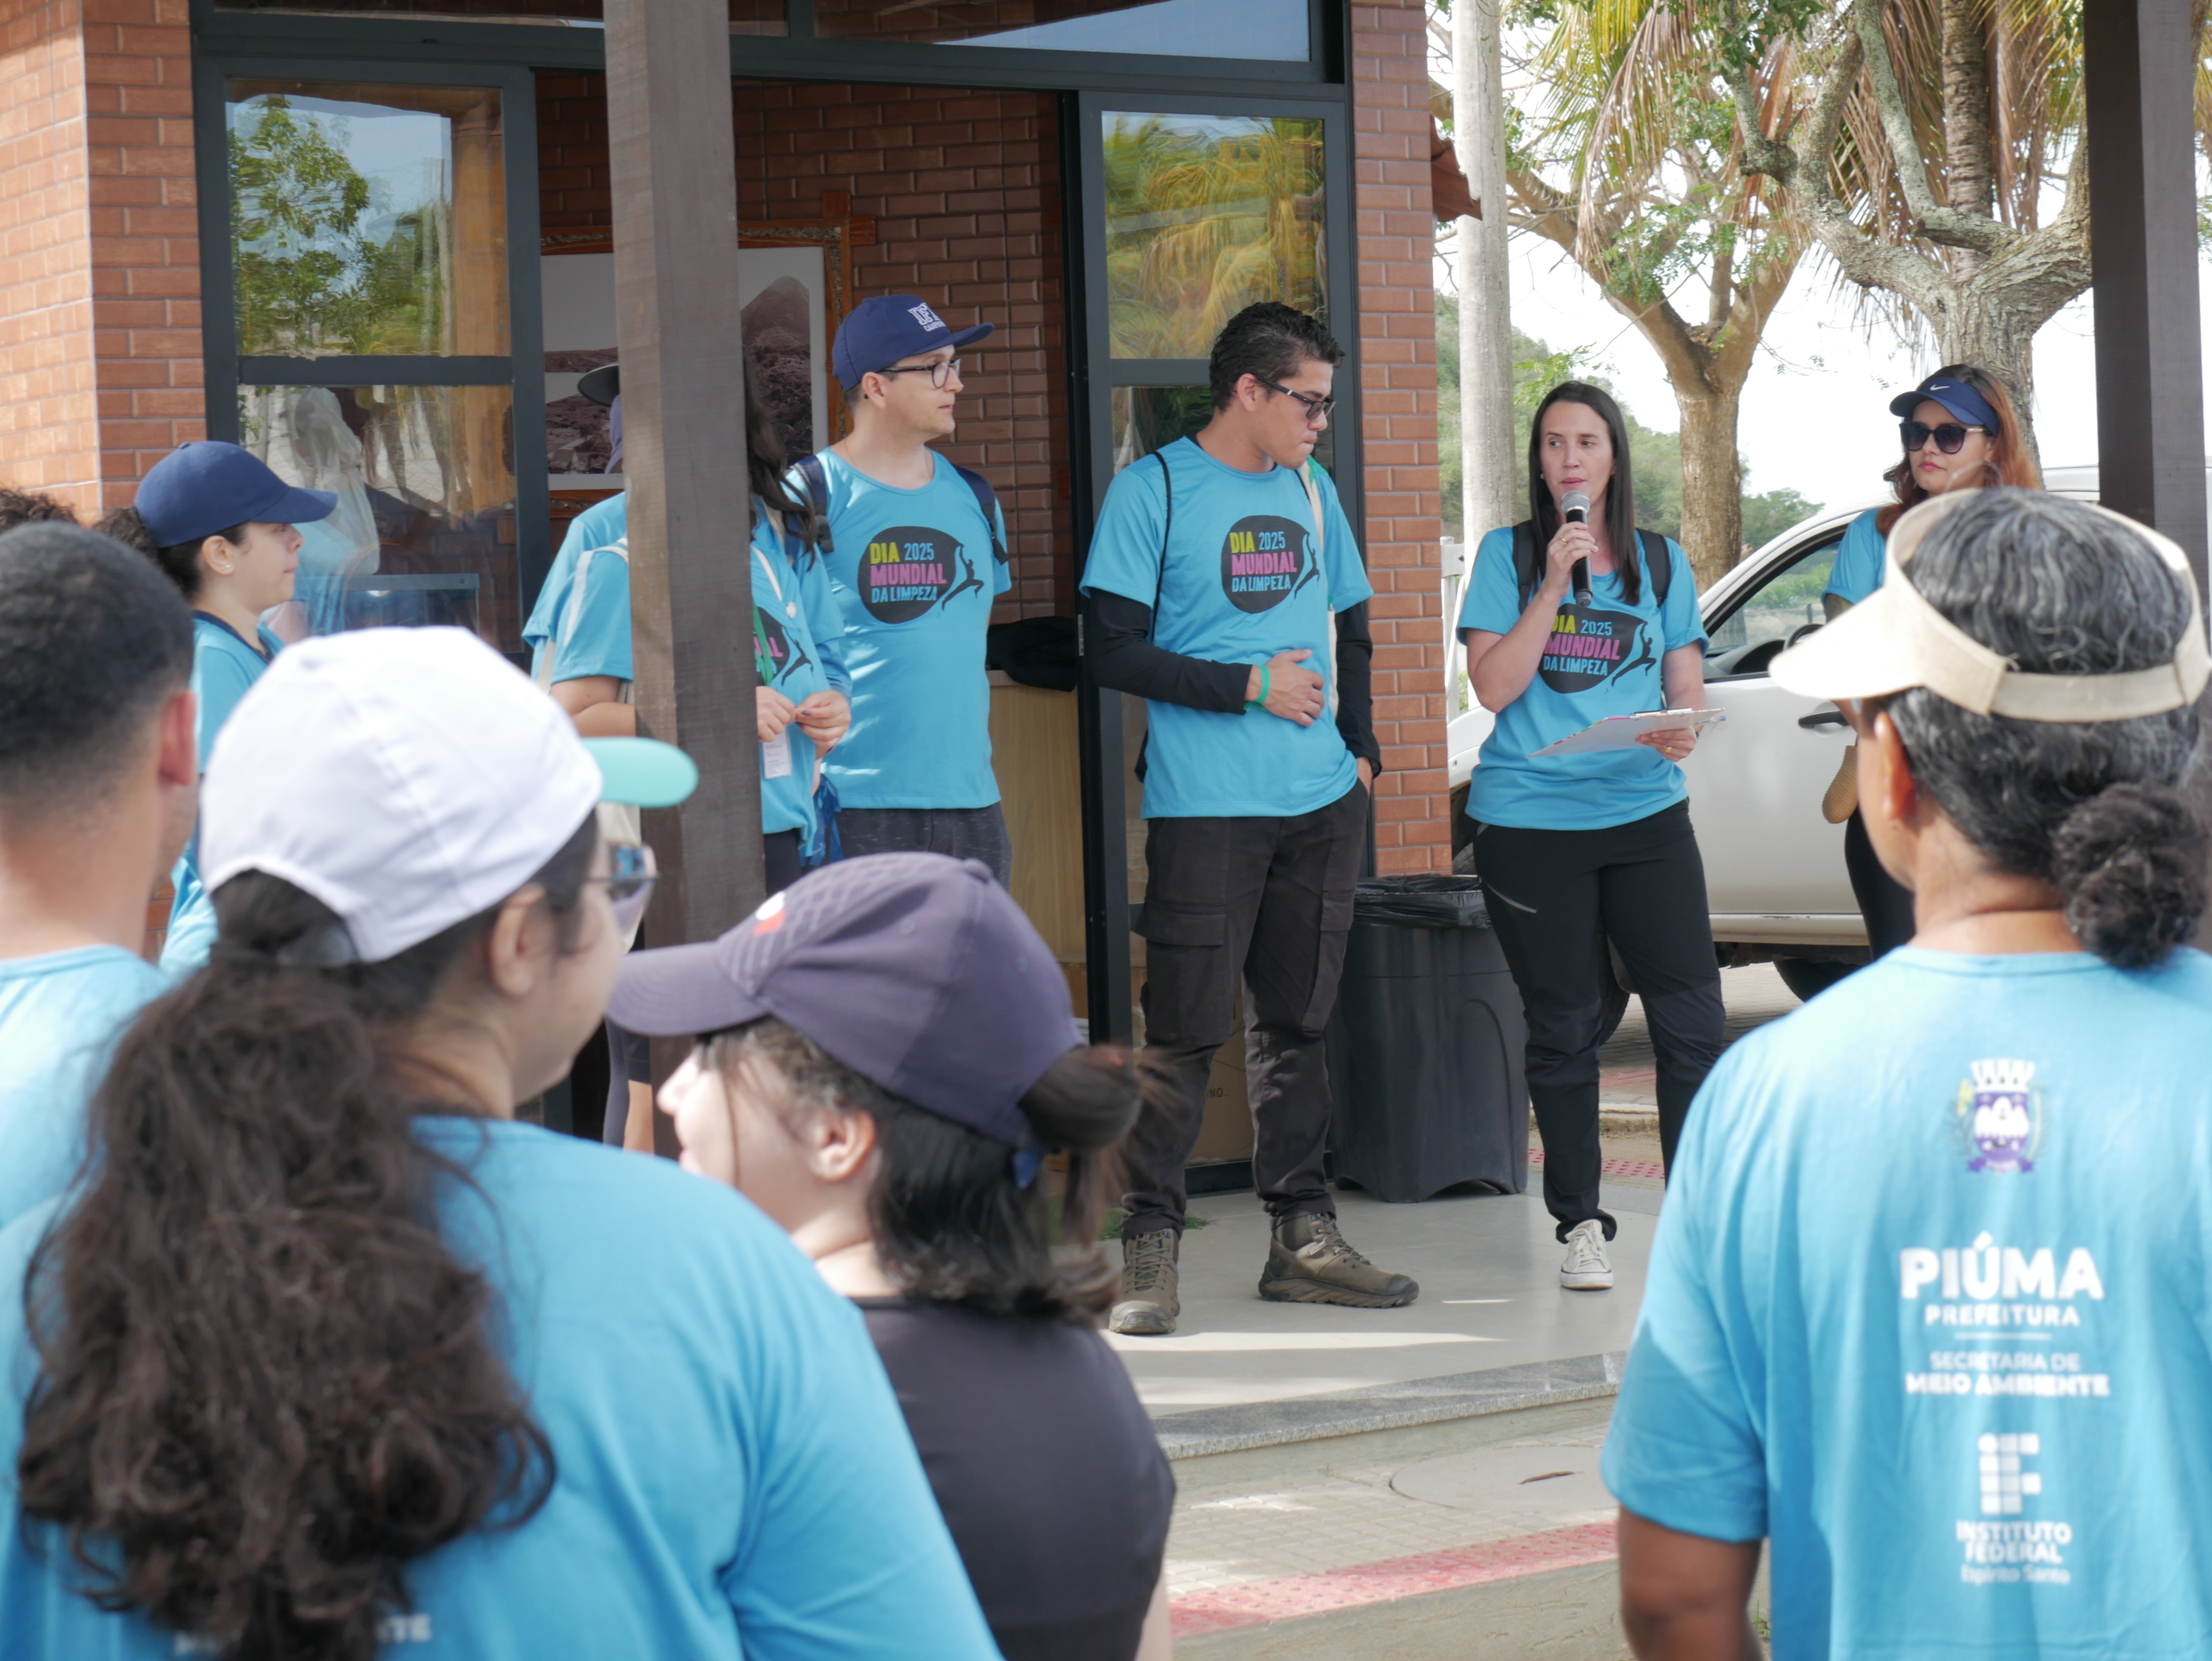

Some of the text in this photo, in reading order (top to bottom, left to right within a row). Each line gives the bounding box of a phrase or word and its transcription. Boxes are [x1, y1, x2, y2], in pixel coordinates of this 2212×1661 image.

[870, 542, 935, 564] DIA 2025
[1229, 531, 1286, 553] DIA 2025
[870, 563, 948, 586] MUNDIAL
[1232, 552, 1297, 575] MUNDIAL
[871, 586, 938, 603] DA LIMPEZA
[1232, 575, 1291, 592] DA LIMPEZA
[1580, 620, 1612, 635] 2025
[1543, 634, 1620, 660] MUNDIAL
[1543, 656, 1608, 676] DA LIMPEZA
[1900, 1231, 2105, 1301] PIÚMA
[1924, 1304, 2081, 1327] PREFEITURA
[1929, 1351, 2081, 1372] SECRETARIA DE
[1905, 1372, 2111, 1397] MEIO AMBIENTE
[1956, 1520, 2073, 1544] INSTITUTO
[1965, 1542, 2064, 1564] FEDERAL
